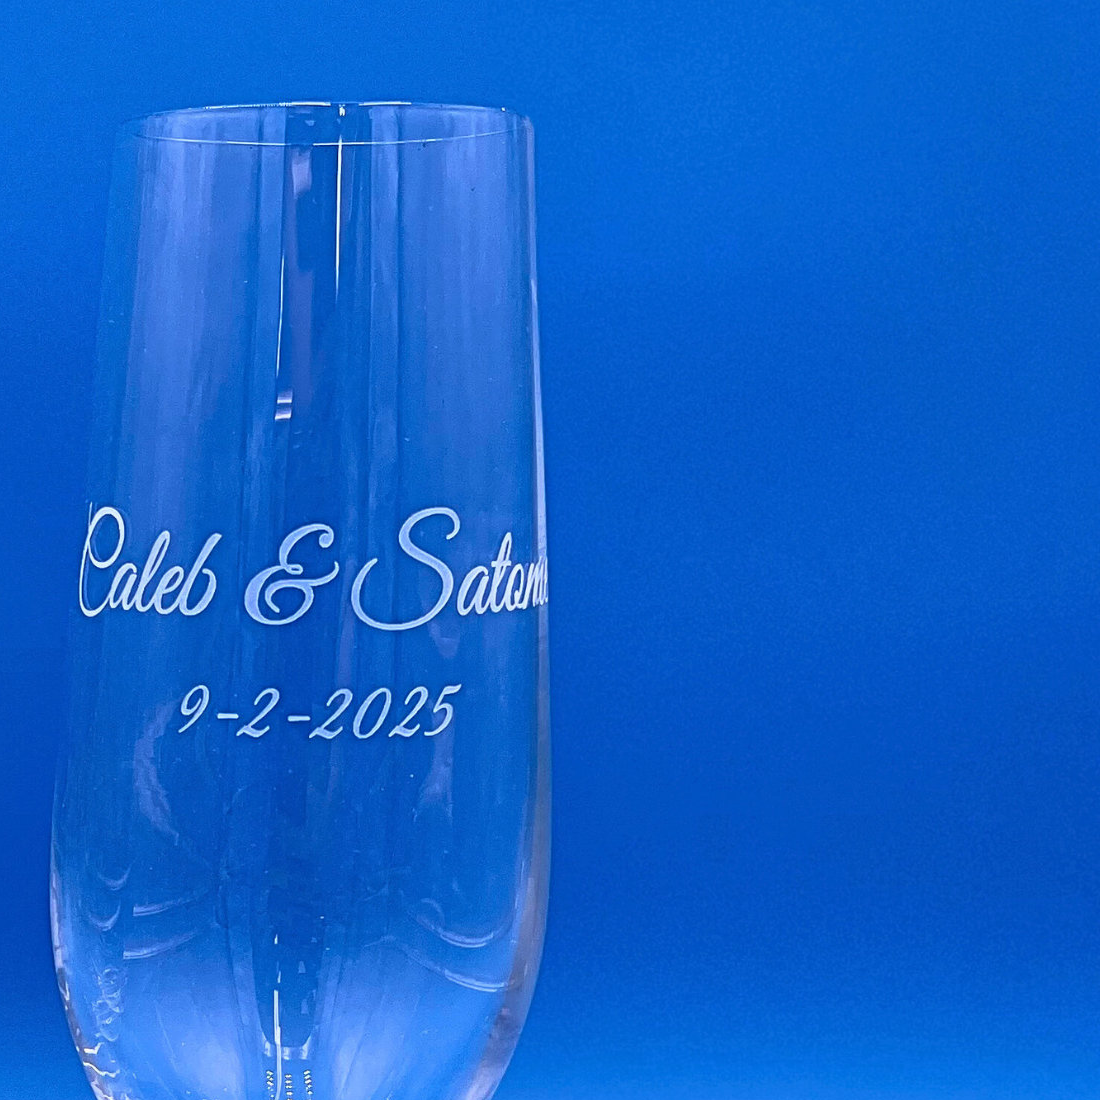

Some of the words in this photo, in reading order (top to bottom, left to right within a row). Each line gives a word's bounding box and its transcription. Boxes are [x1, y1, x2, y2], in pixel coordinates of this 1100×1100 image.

[78, 506, 223, 617] Caleb
[243, 523, 340, 626] &
[177, 683, 463, 740] 9-2-2025
